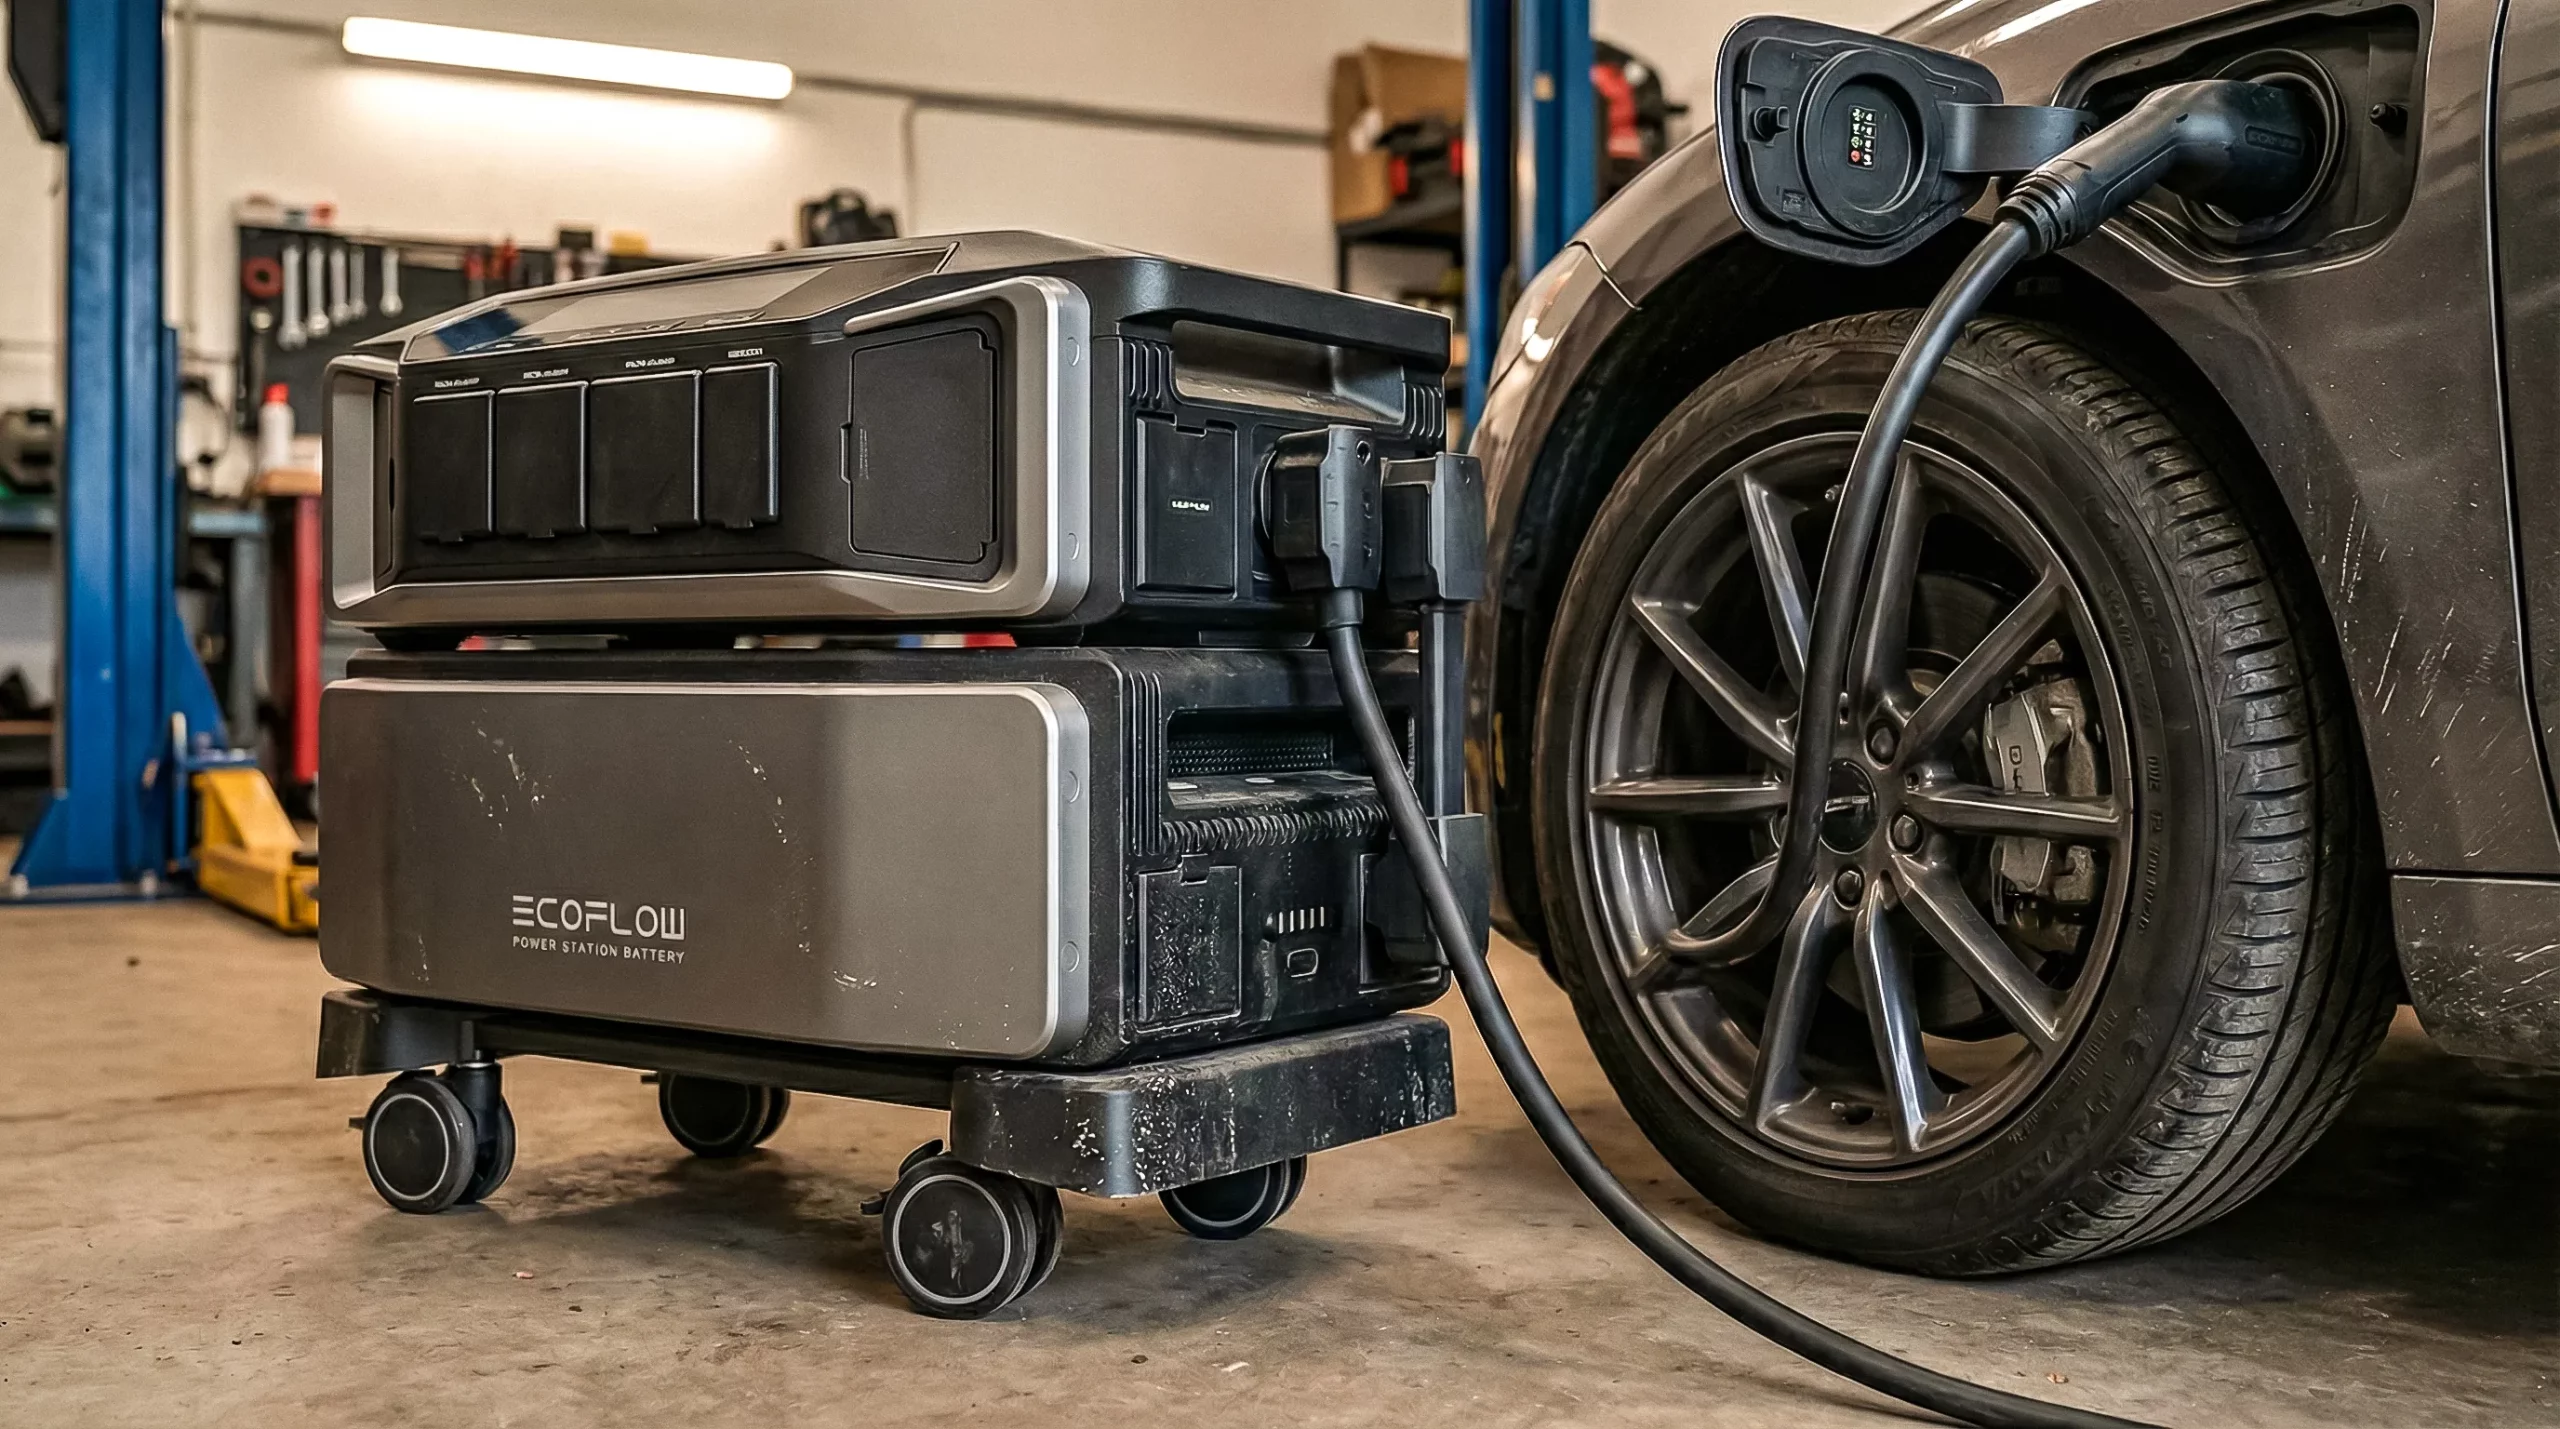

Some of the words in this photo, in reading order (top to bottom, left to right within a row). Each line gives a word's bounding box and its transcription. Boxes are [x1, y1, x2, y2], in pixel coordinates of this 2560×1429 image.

[512, 895, 685, 940] ECOFLOW
[512, 936, 557, 951] POWER
[562, 940, 618, 957] STATION
[623, 946, 685, 964] BATTERY
